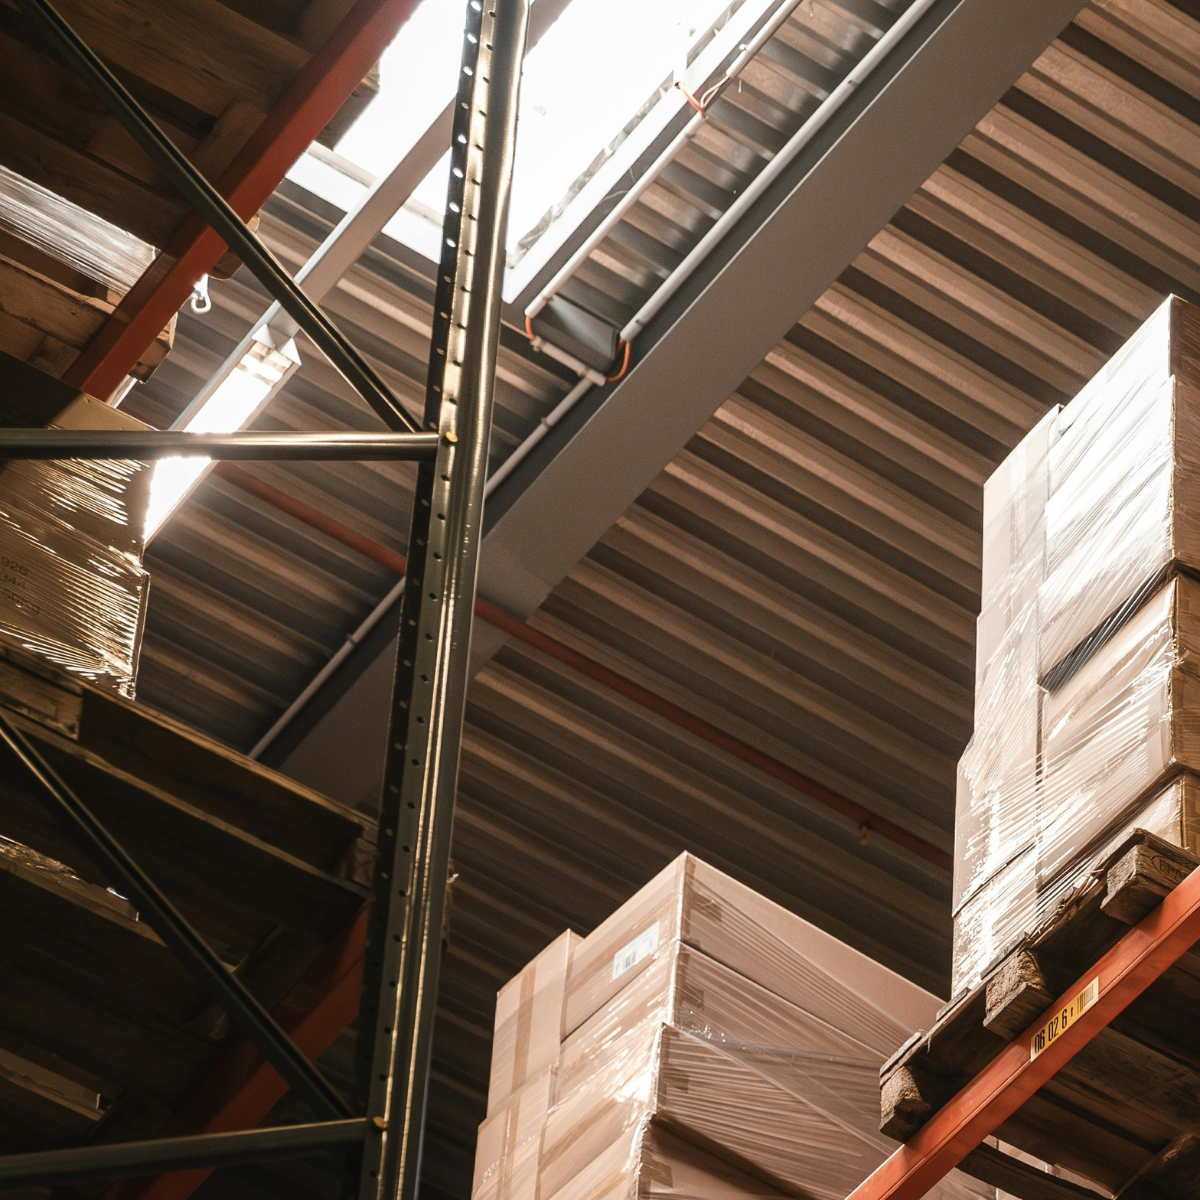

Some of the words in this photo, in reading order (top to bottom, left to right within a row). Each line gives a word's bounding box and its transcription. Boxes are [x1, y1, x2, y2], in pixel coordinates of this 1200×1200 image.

[1034, 1029, 1045, 1054] 06
[1048, 1016, 1059, 1042] 02
[1062, 1008, 1067, 1029] 6
